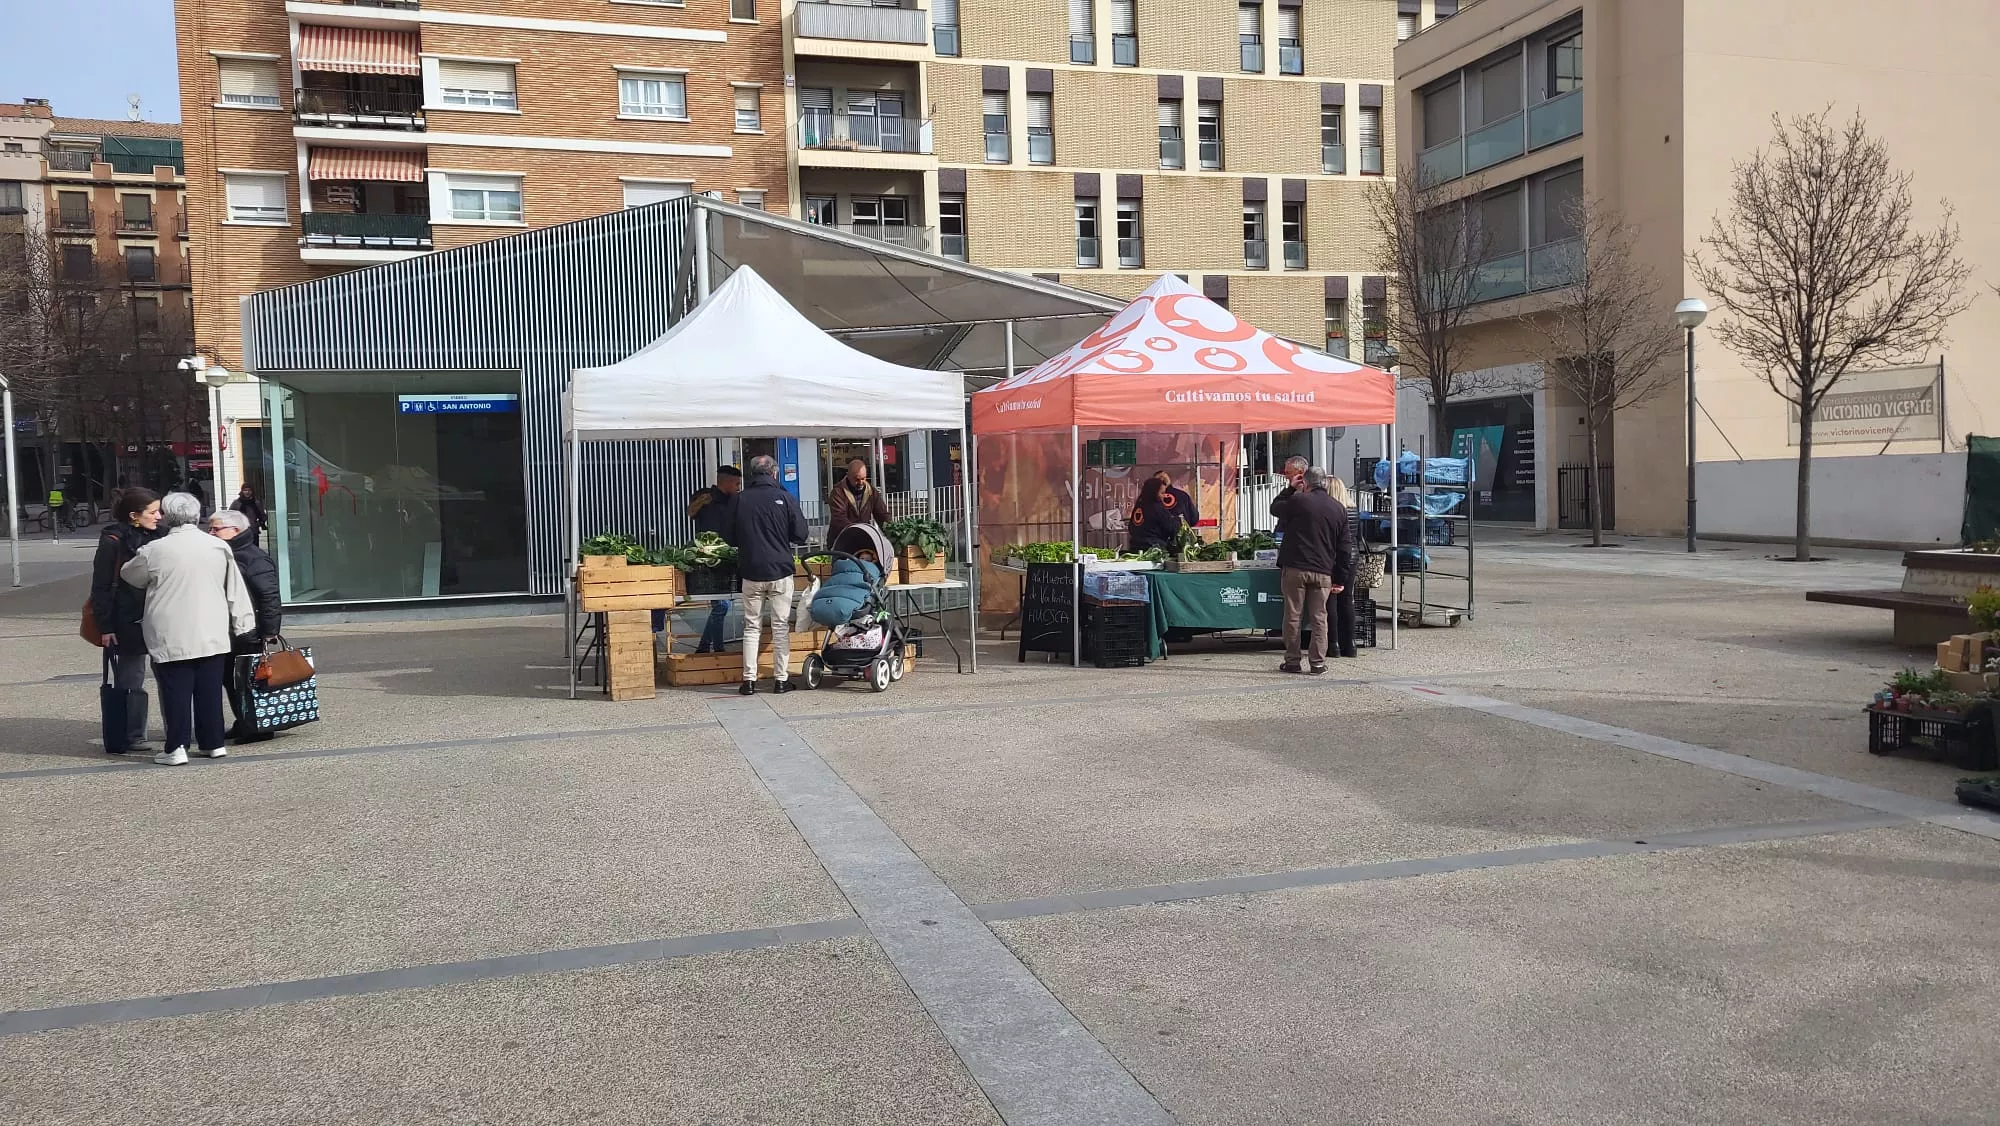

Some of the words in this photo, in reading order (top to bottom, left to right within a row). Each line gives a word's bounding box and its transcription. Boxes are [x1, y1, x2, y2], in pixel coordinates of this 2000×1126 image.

[1165, 389, 1252, 403] Cultivamos
[1255, 390, 1272, 402] tu
[1275, 390, 1316, 403] salud
[1822, 403, 1881, 421] VICTORINO
[1885, 399, 1933, 417] VICENTE
[1064, 477, 1140, 499] Valenti
[1113, 501, 1134, 509] EMP
